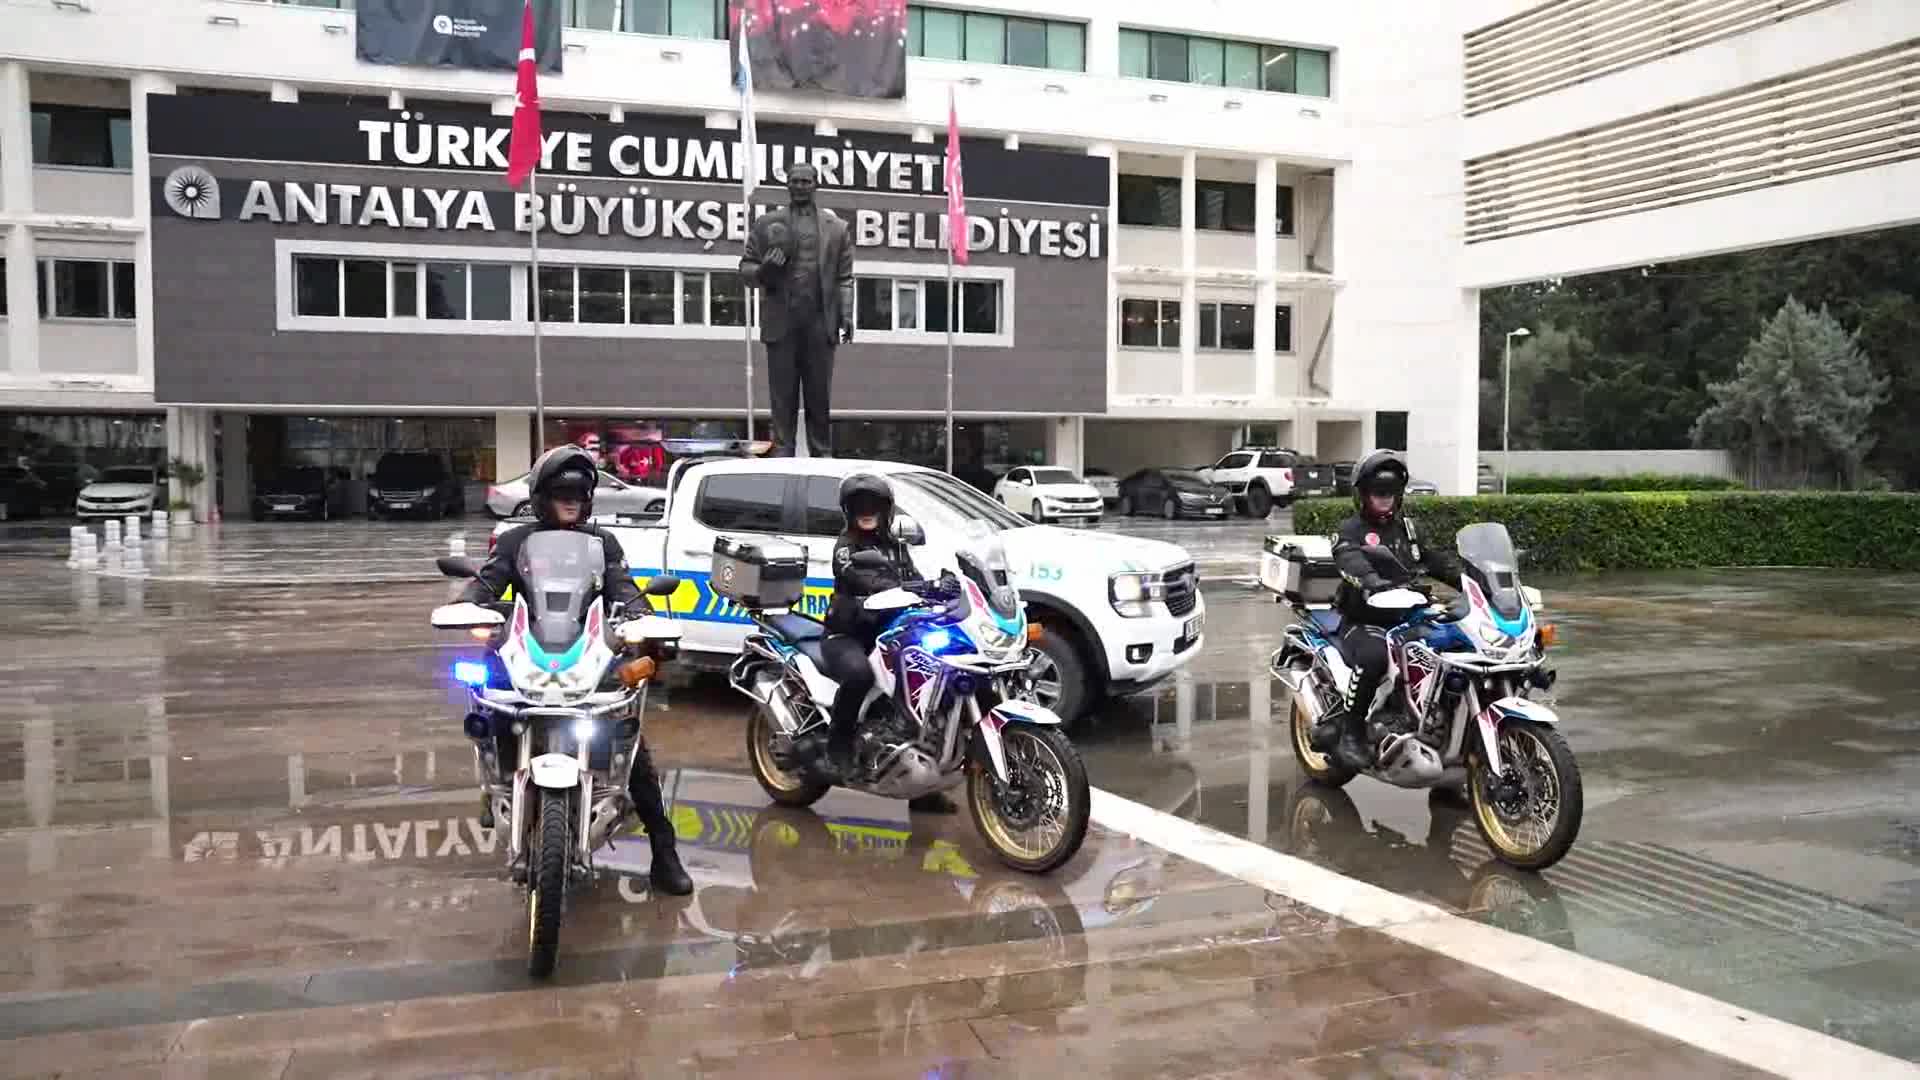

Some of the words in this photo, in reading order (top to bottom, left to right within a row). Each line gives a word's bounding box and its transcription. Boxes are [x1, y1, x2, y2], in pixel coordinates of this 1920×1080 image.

[359, 111, 593, 173] TÜRKYE
[239, 179, 496, 232] ANTALYA
[514, 183, 836, 251] BÜYÜKŞE
[1030, 560, 1063, 581] 153
